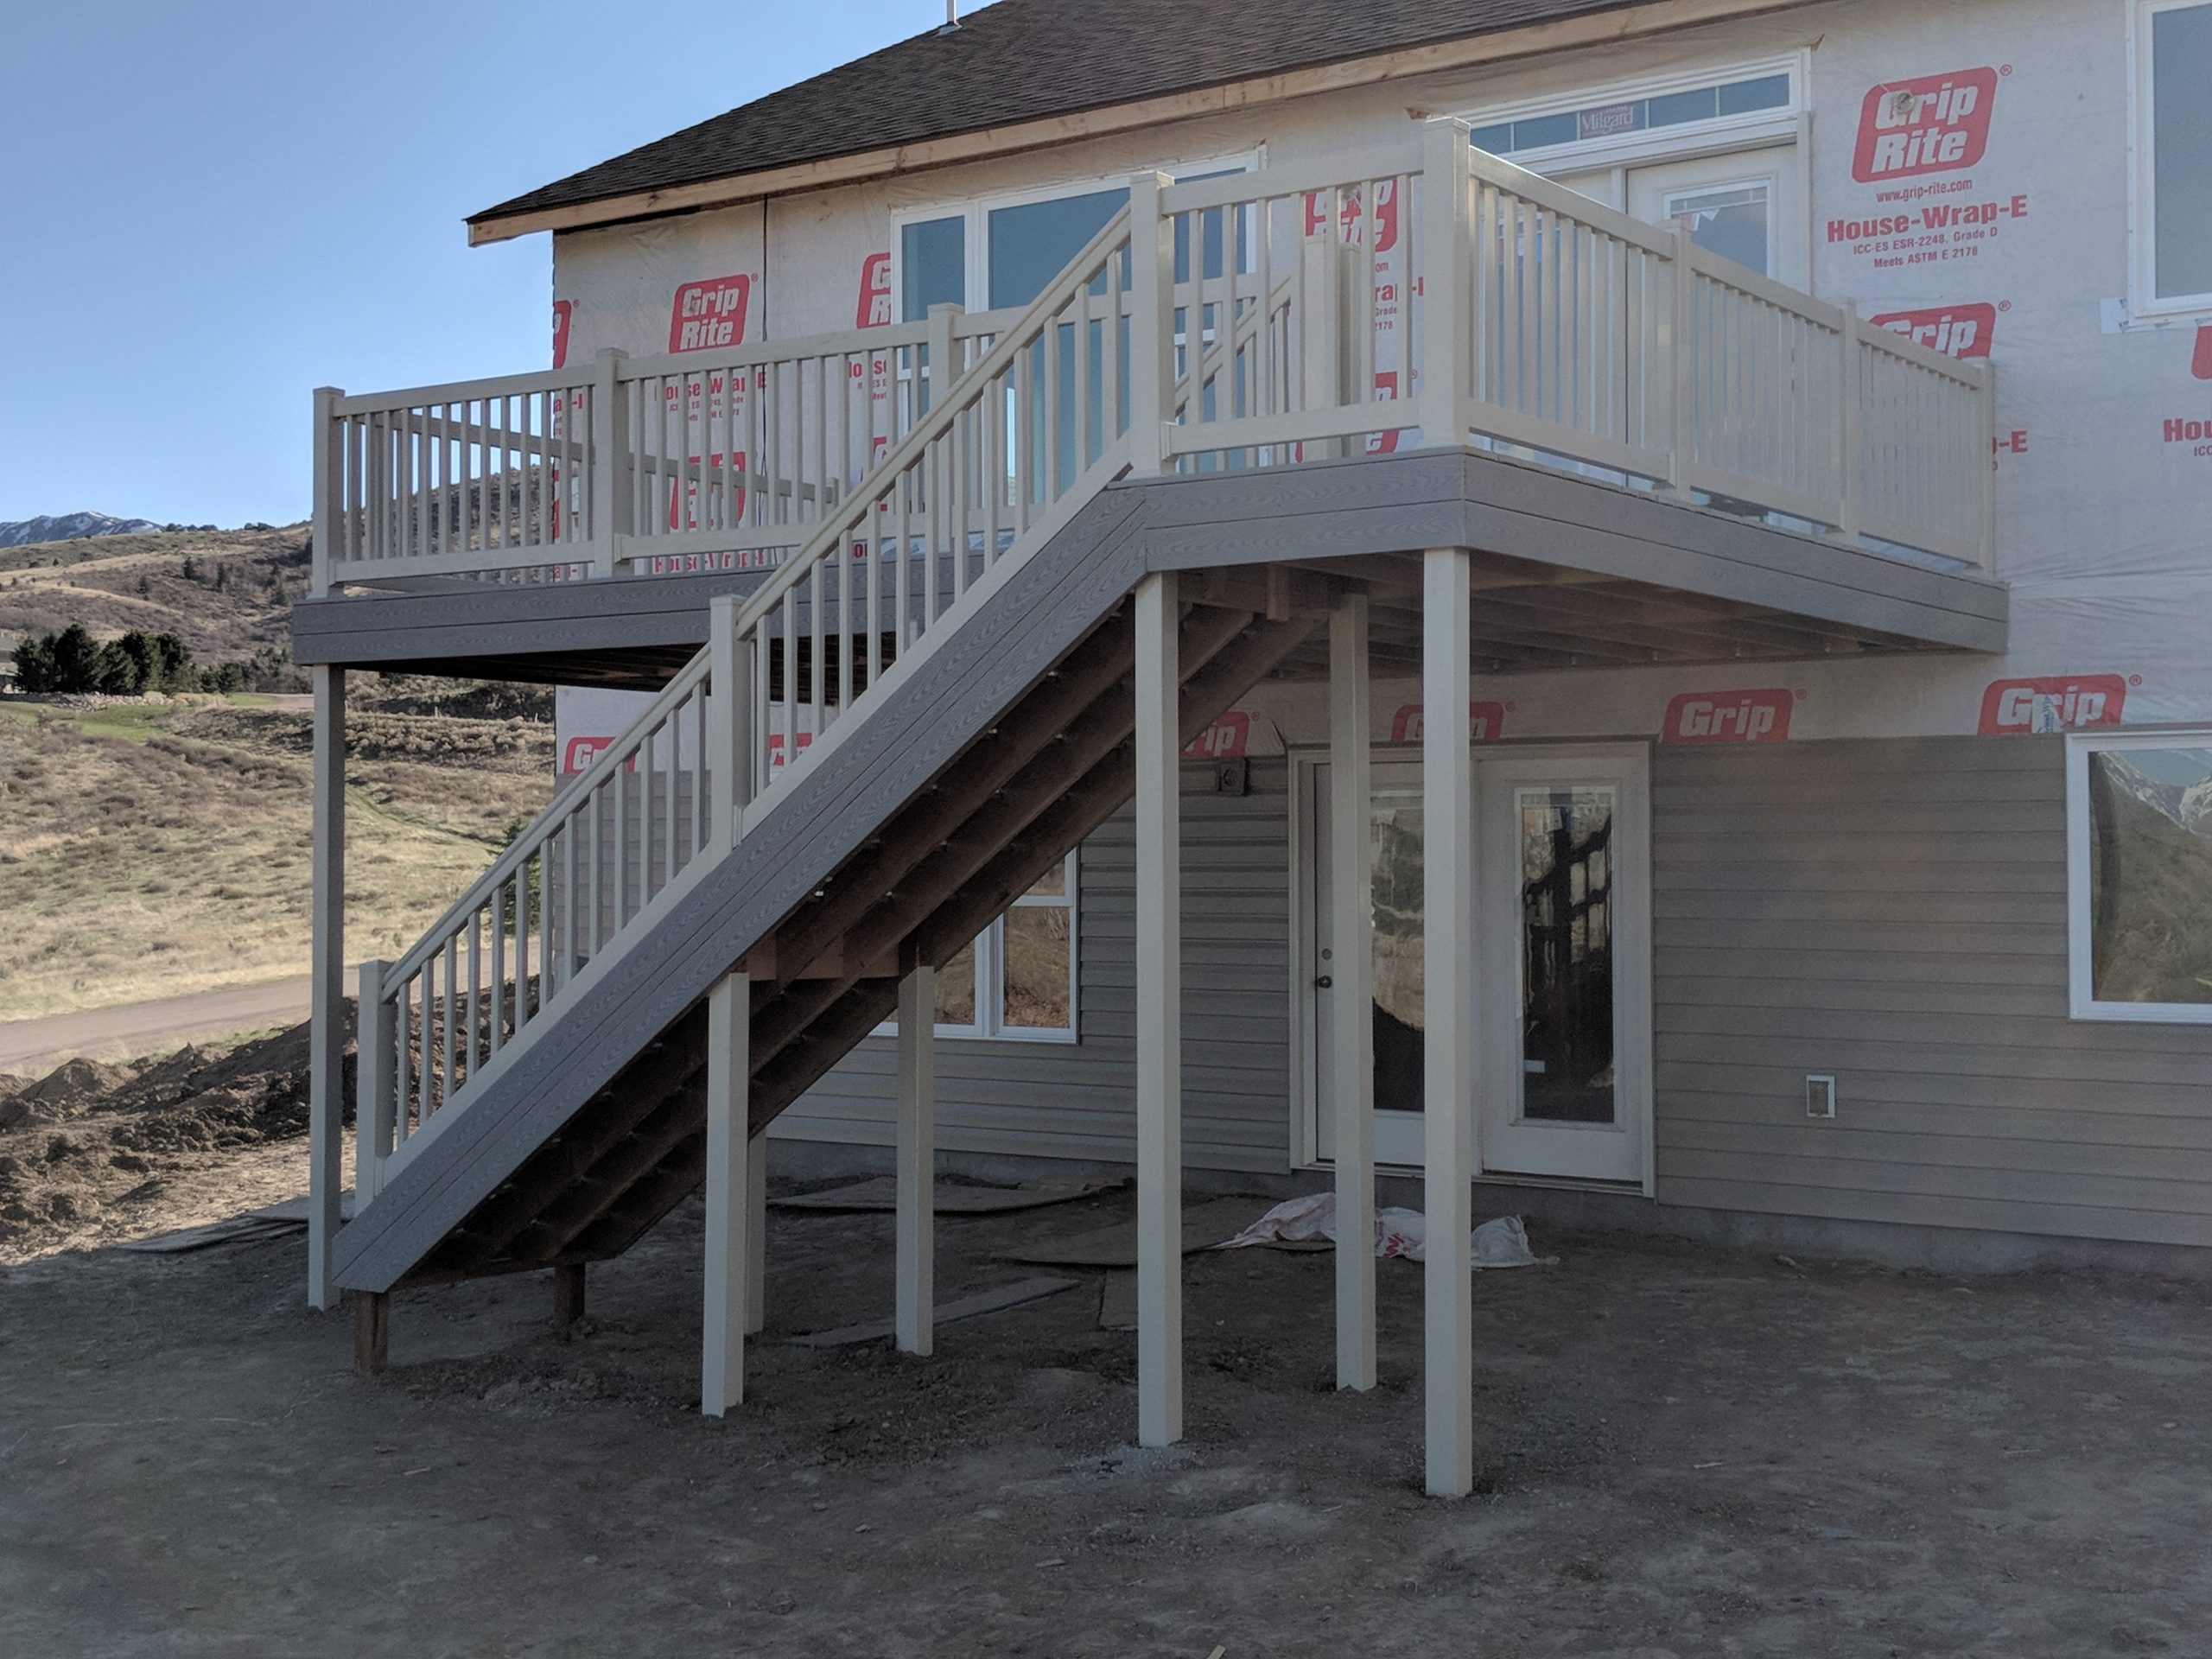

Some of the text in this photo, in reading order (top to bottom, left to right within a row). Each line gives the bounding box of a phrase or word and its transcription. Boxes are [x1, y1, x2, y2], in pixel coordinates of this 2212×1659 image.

[1581, 106, 1634, 134] Milgard
[1875, 82, 1979, 130] Grip
[1871, 127, 1967, 174] Rite
[1876, 179, 1973, 203] www.grip-rite.com
[1827, 194, 2028, 243] House-Wrap-E
[1954, 227, 1986, 242] Grade
[1990, 227, 1998, 237] D
[1907, 251, 1937, 264] ASTM
[1942, 251, 1948, 260] E
[1953, 246, 1979, 257] 2178
[682, 285, 740, 318] Grip
[679, 316, 734, 349] Rite
[1679, 699, 1776, 741] Grip
